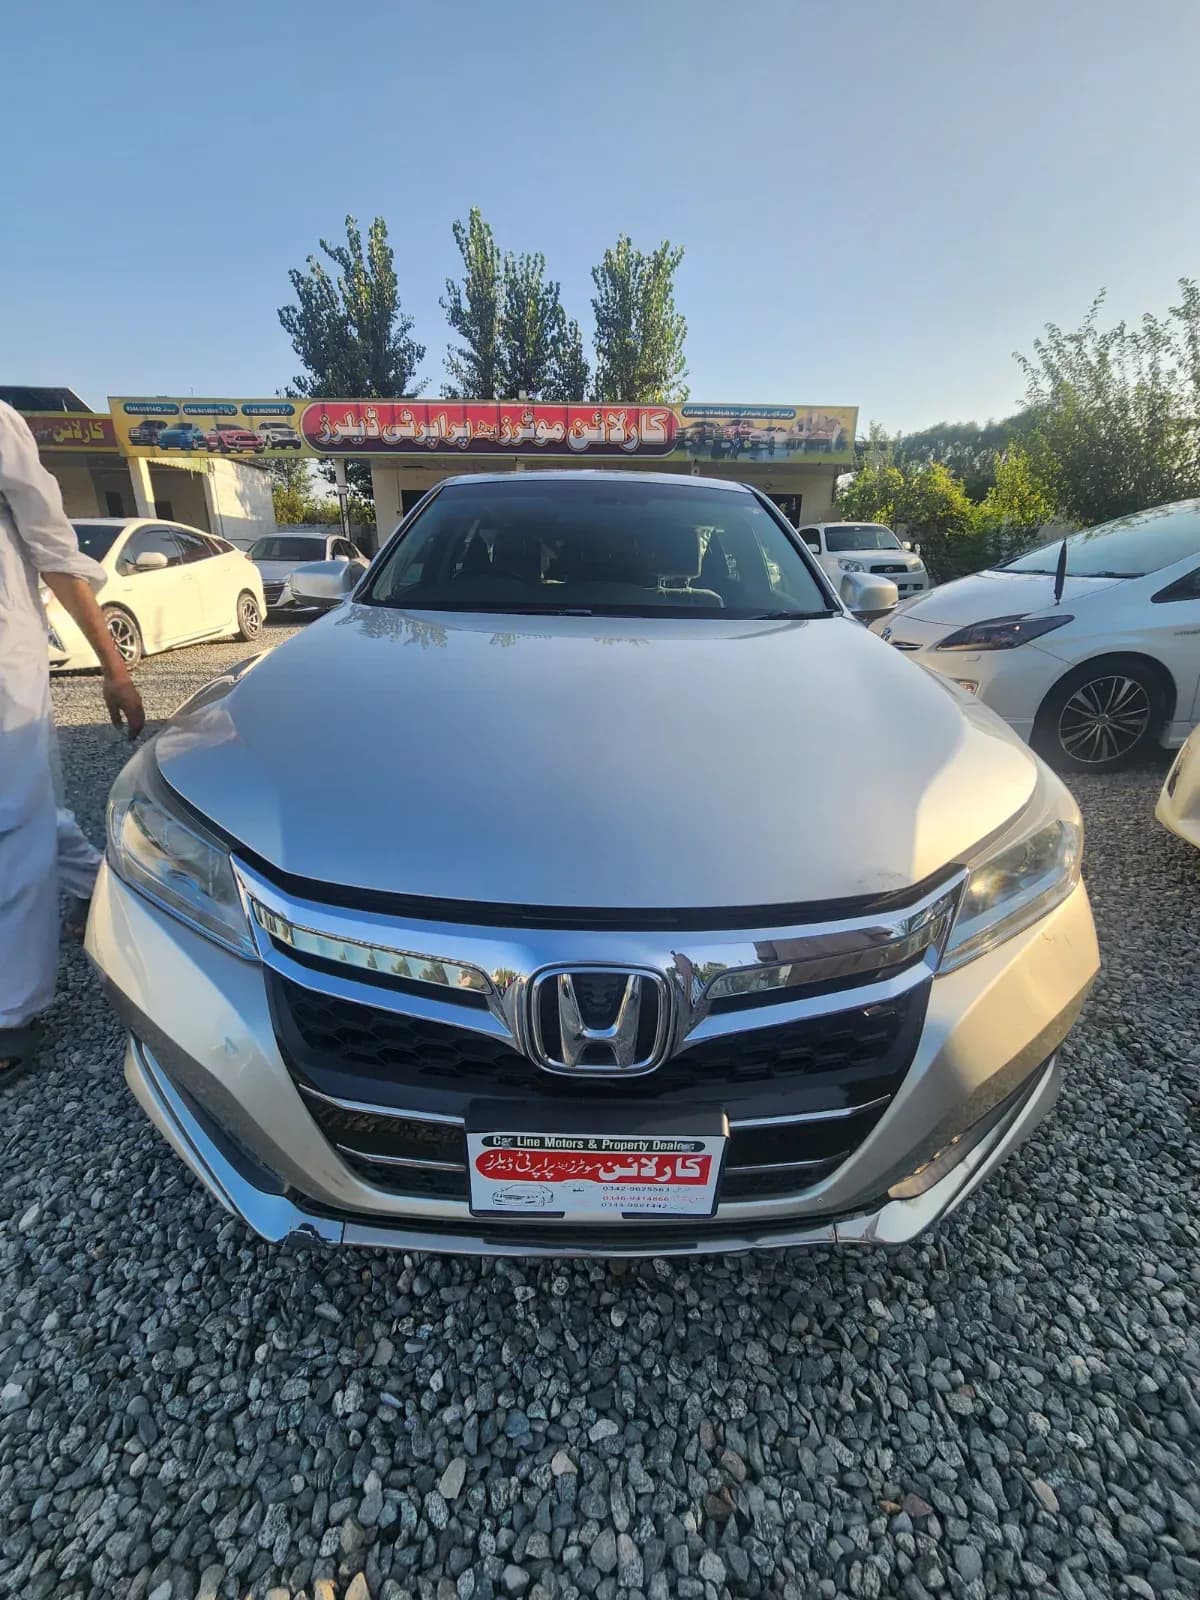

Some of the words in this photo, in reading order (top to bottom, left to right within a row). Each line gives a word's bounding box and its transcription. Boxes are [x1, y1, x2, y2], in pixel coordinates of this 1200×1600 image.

[317, 407, 380, 444] ڈیلرز
[383, 408, 472, 448] پراپرٹی
[499, 411, 565, 446] موٹرز
[568, 411, 668, 450] کارلائن
[517, 1136, 540, 1147] Line
[544, 1137, 584, 1149] Motors
[587, 1139, 598, 1149] &
[602, 1140, 647, 1151] Property
[484, 1152, 513, 1171] ڈیلرز
[515, 1151, 556, 1179] پراپرٹی
[567, 1158, 602, 1174] موٹرز
[598, 1156, 703, 1182] کارلائن
